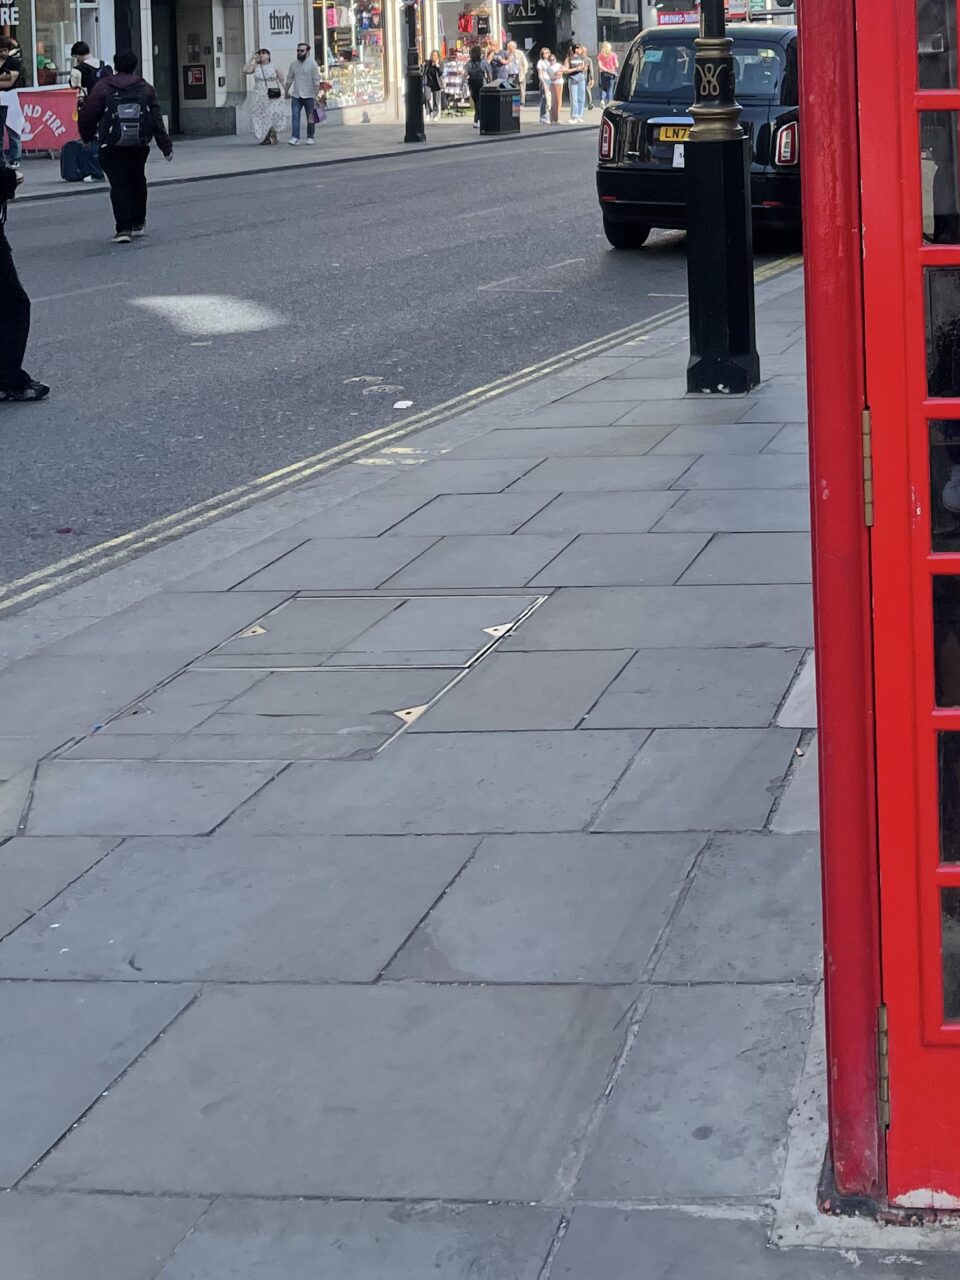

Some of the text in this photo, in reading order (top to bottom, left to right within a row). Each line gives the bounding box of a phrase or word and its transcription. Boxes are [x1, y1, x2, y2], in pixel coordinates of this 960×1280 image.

[269, 8, 295, 34] thirty
[23, 104, 66, 137] ND FIRE
